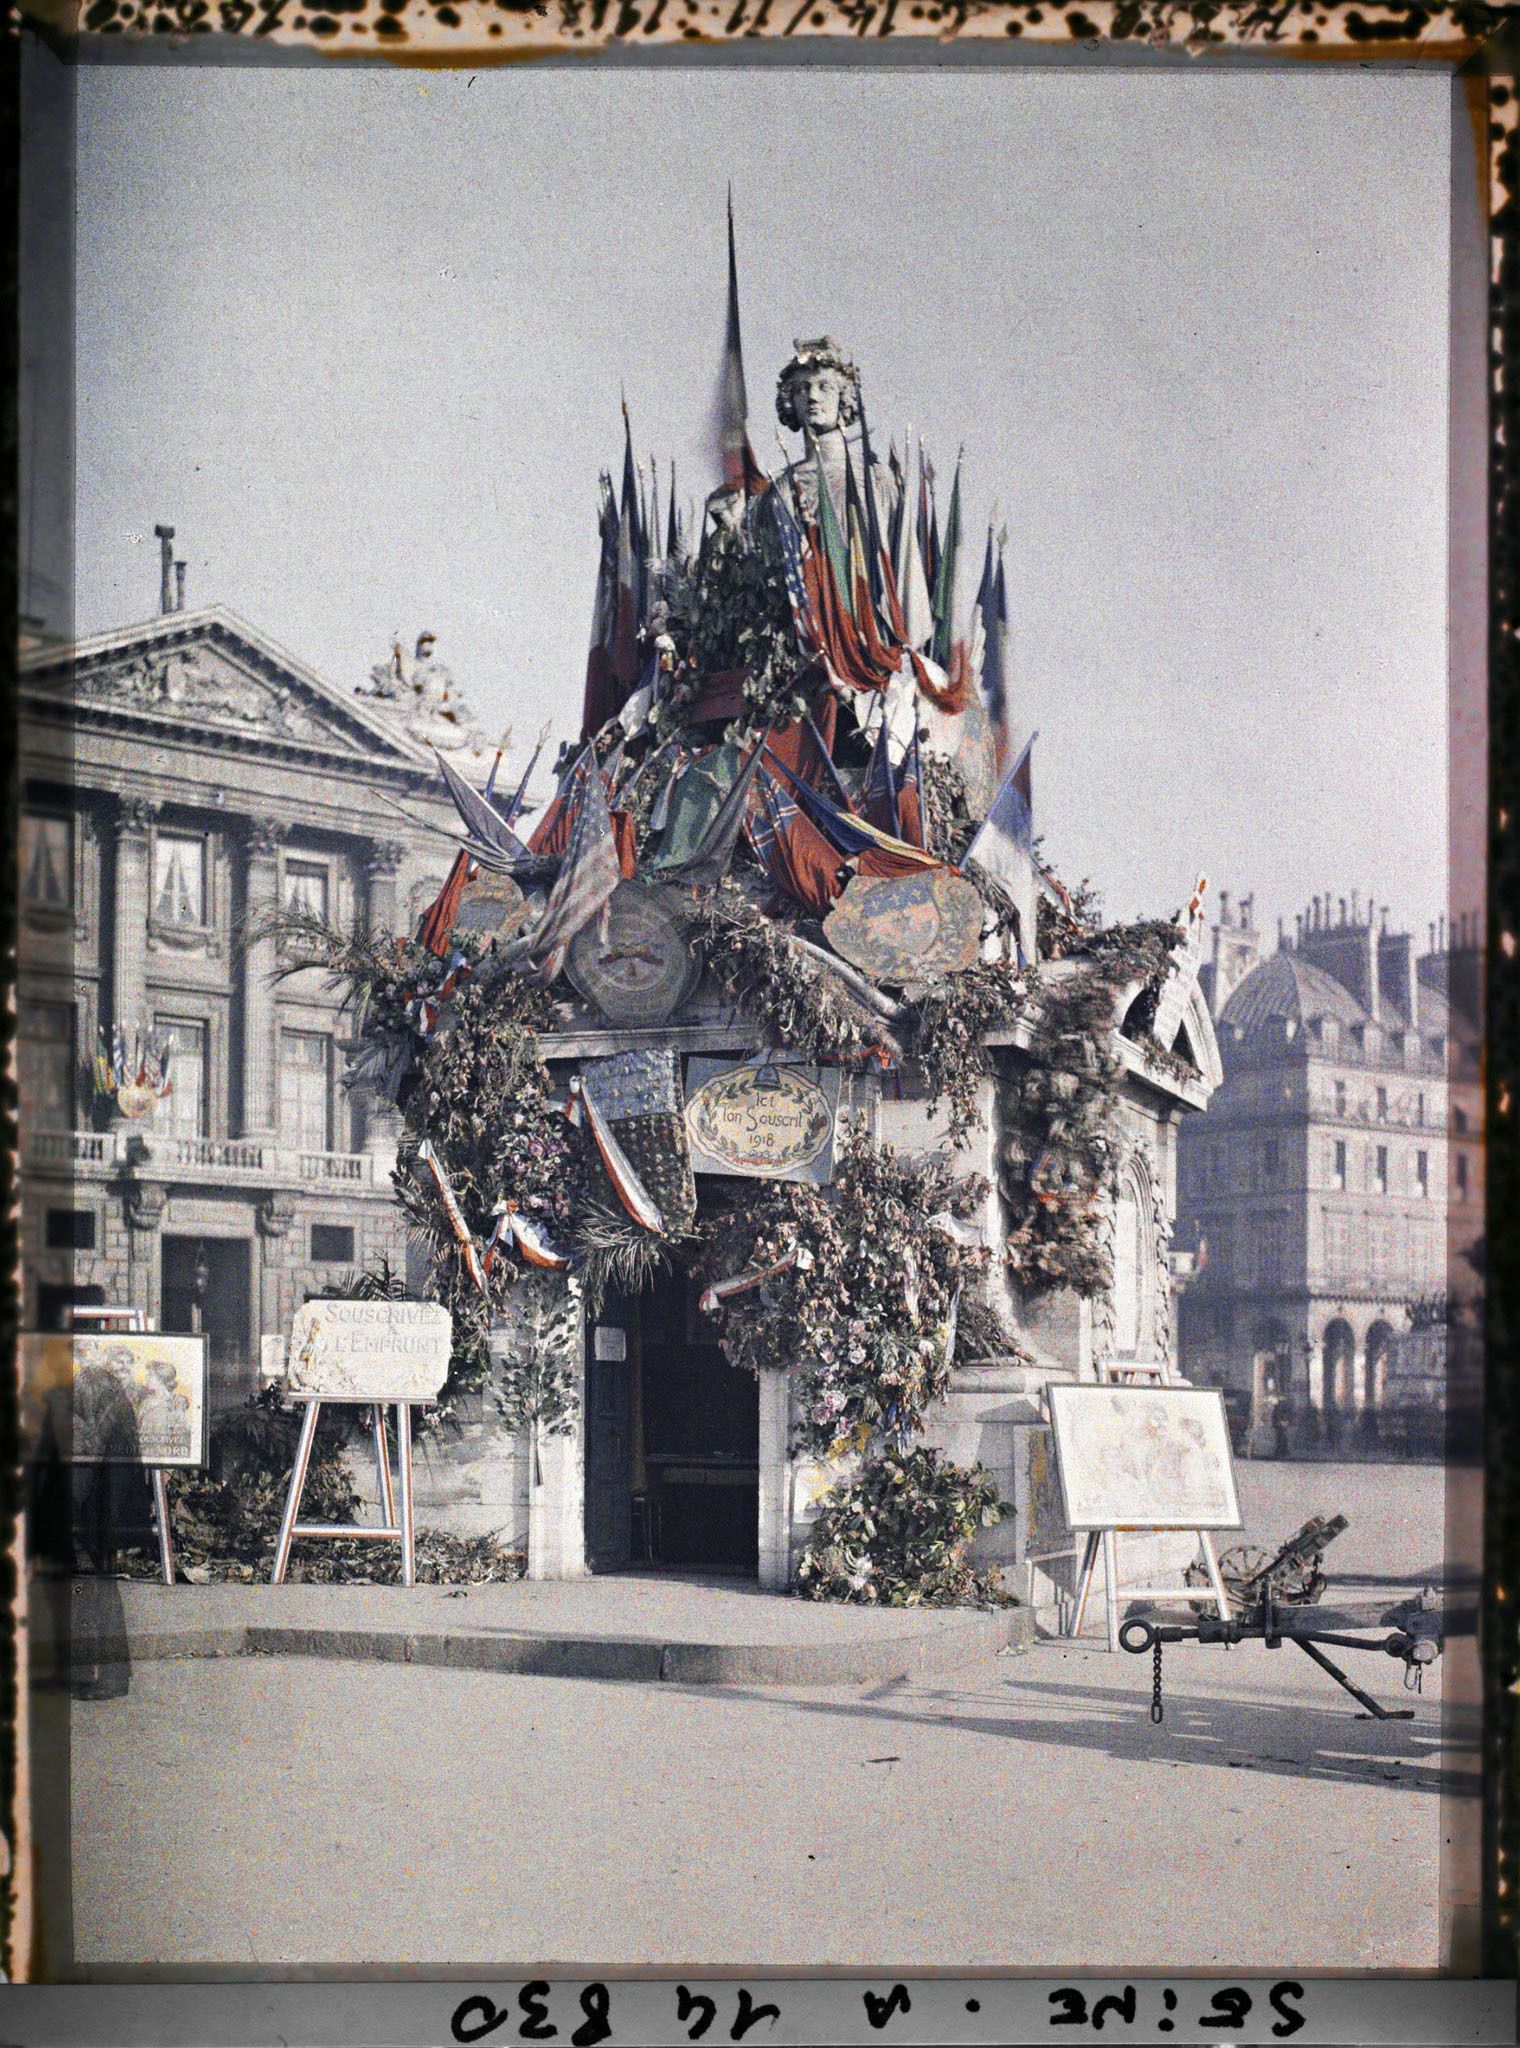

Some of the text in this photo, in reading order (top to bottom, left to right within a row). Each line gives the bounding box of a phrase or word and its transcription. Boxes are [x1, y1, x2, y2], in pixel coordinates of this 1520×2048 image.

[748, 1132, 775, 1148] 1918
[451, 1980, 612, 2047] 830
[676, 1985, 781, 2040] 14
[863, 1984, 910, 2029] A
